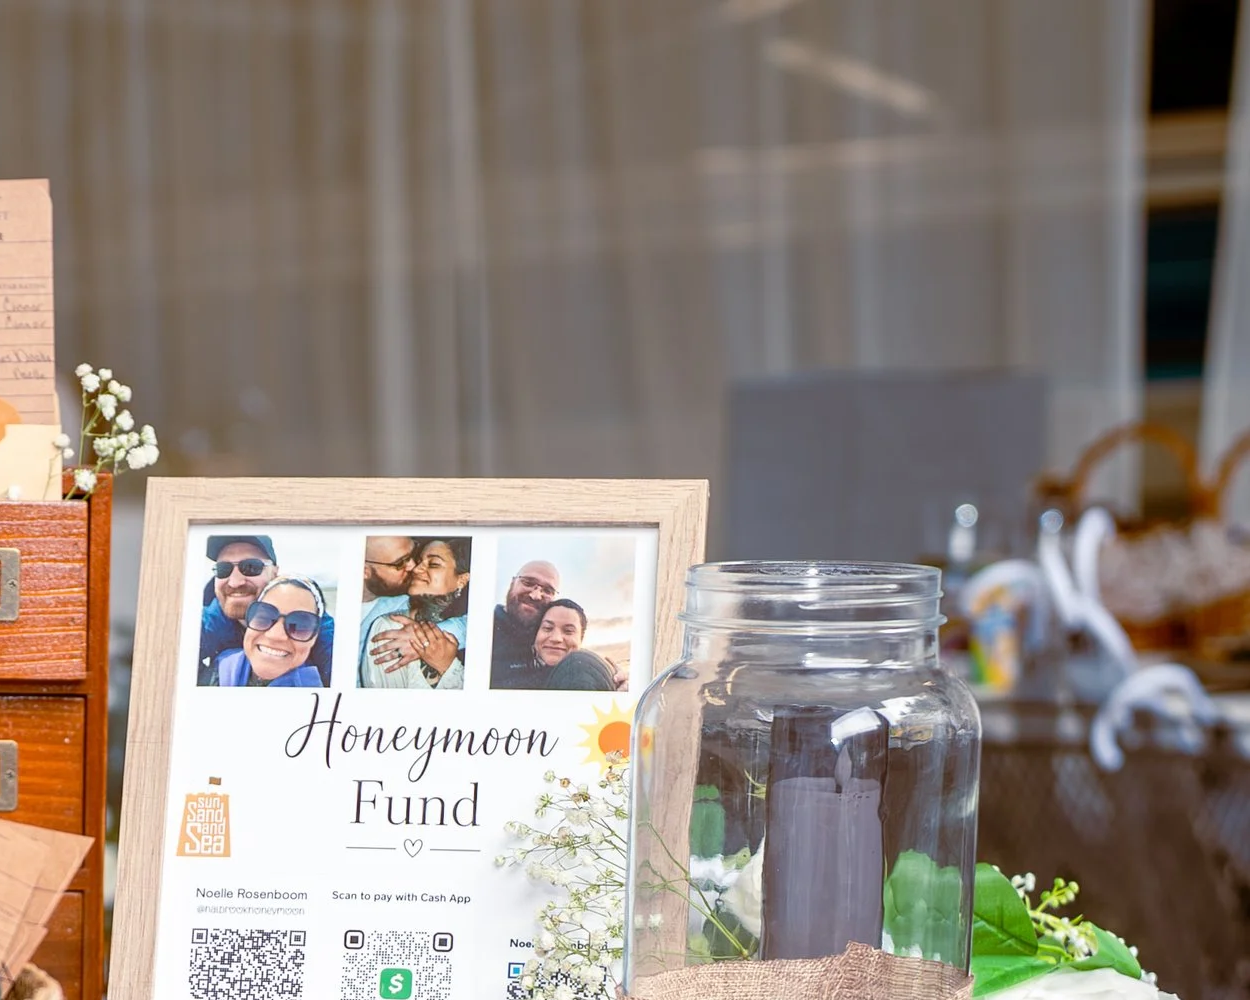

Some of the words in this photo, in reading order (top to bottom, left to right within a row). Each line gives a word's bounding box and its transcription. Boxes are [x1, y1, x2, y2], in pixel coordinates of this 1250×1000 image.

[284, 691, 560, 783] Honeymoon
[349, 778, 481, 828] Fund
[184, 822, 225, 855] Sea
[196, 887, 234, 898] Noelle
[237, 888, 308, 900] Rosenboom
[332, 890, 357, 900] Scan
[360, 892, 371, 900] to
[374, 893, 393, 903] pay
[395, 892, 418, 902] with
[420, 892, 447, 902] Cash
[449, 894, 471, 904] App
